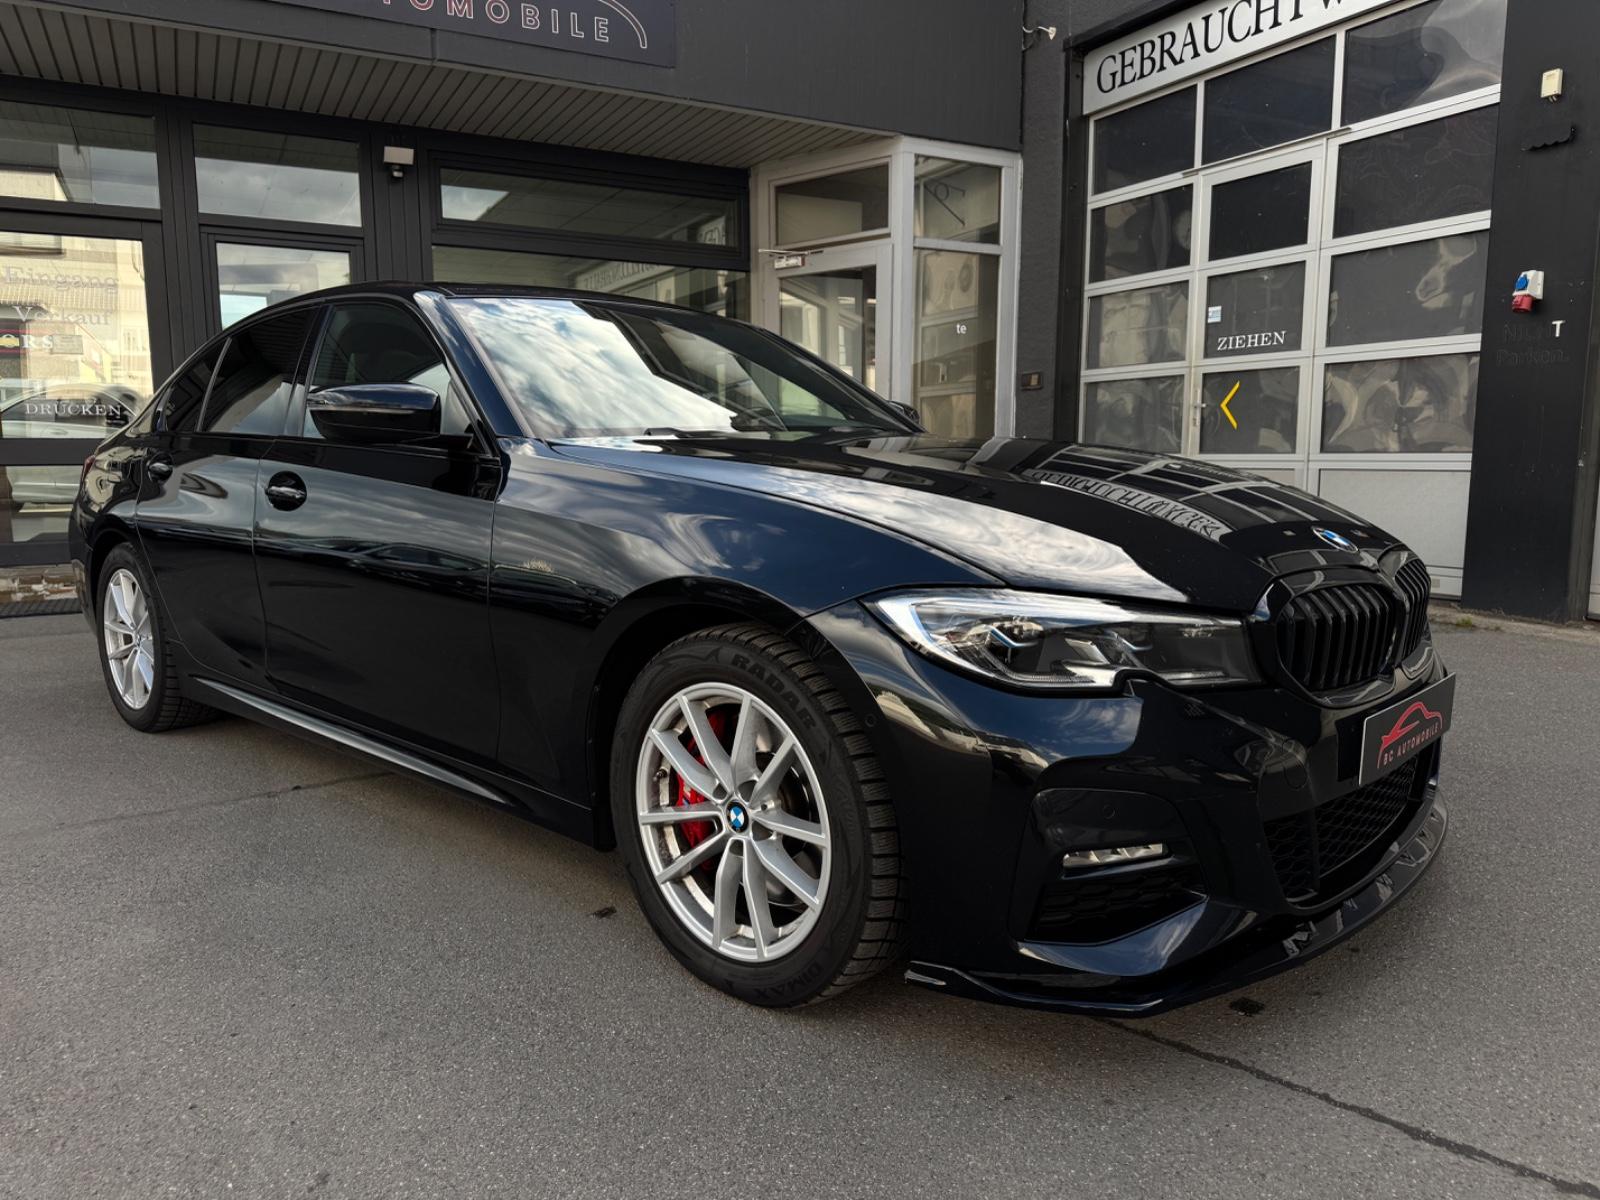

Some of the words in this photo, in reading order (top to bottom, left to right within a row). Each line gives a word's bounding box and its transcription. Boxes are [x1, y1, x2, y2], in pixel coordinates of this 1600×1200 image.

[383, 0, 609, 42] MOBILE
[1096, 0, 1343, 94] GEBRAUCH
[4, 265, 119, 294] Eingang
[12, 304, 113, 326] Verkauf
[956, 323, 968, 334] te
[1217, 331, 1287, 351] ZIEHEN
[731, 654, 816, 729] RADAR
[1383, 750, 1394, 766] BC
[1397, 721, 1439, 757] AUTOMOBILE
